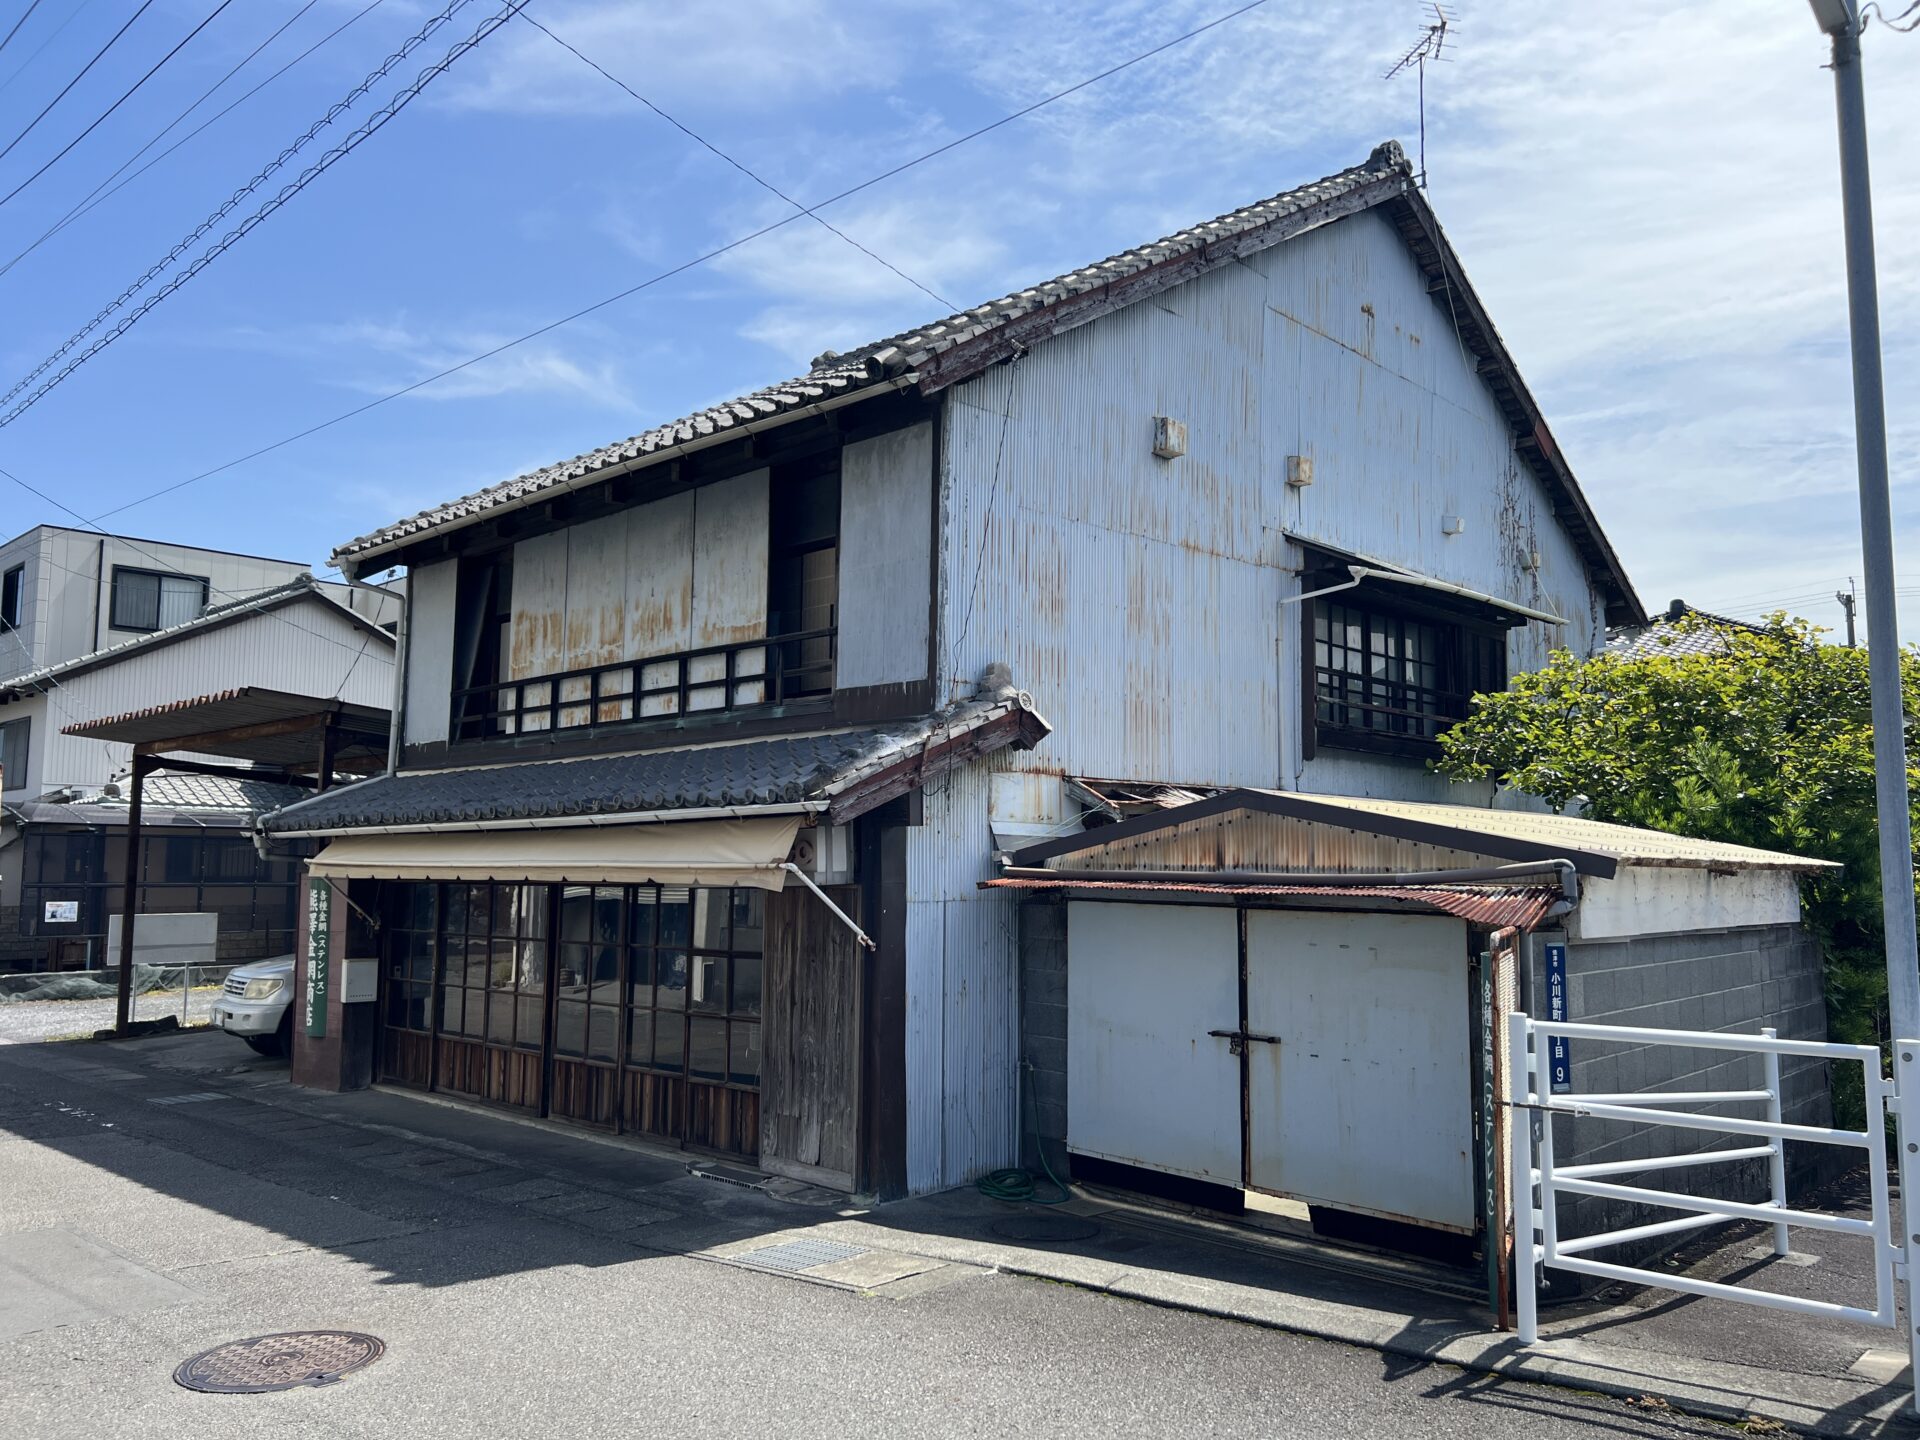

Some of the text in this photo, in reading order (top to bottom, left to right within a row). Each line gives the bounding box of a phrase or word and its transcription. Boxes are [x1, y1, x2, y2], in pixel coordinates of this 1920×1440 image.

[1551, 972, 1563, 1059] 小川新町丁目
[1556, 1066, 1564, 1082] 9
